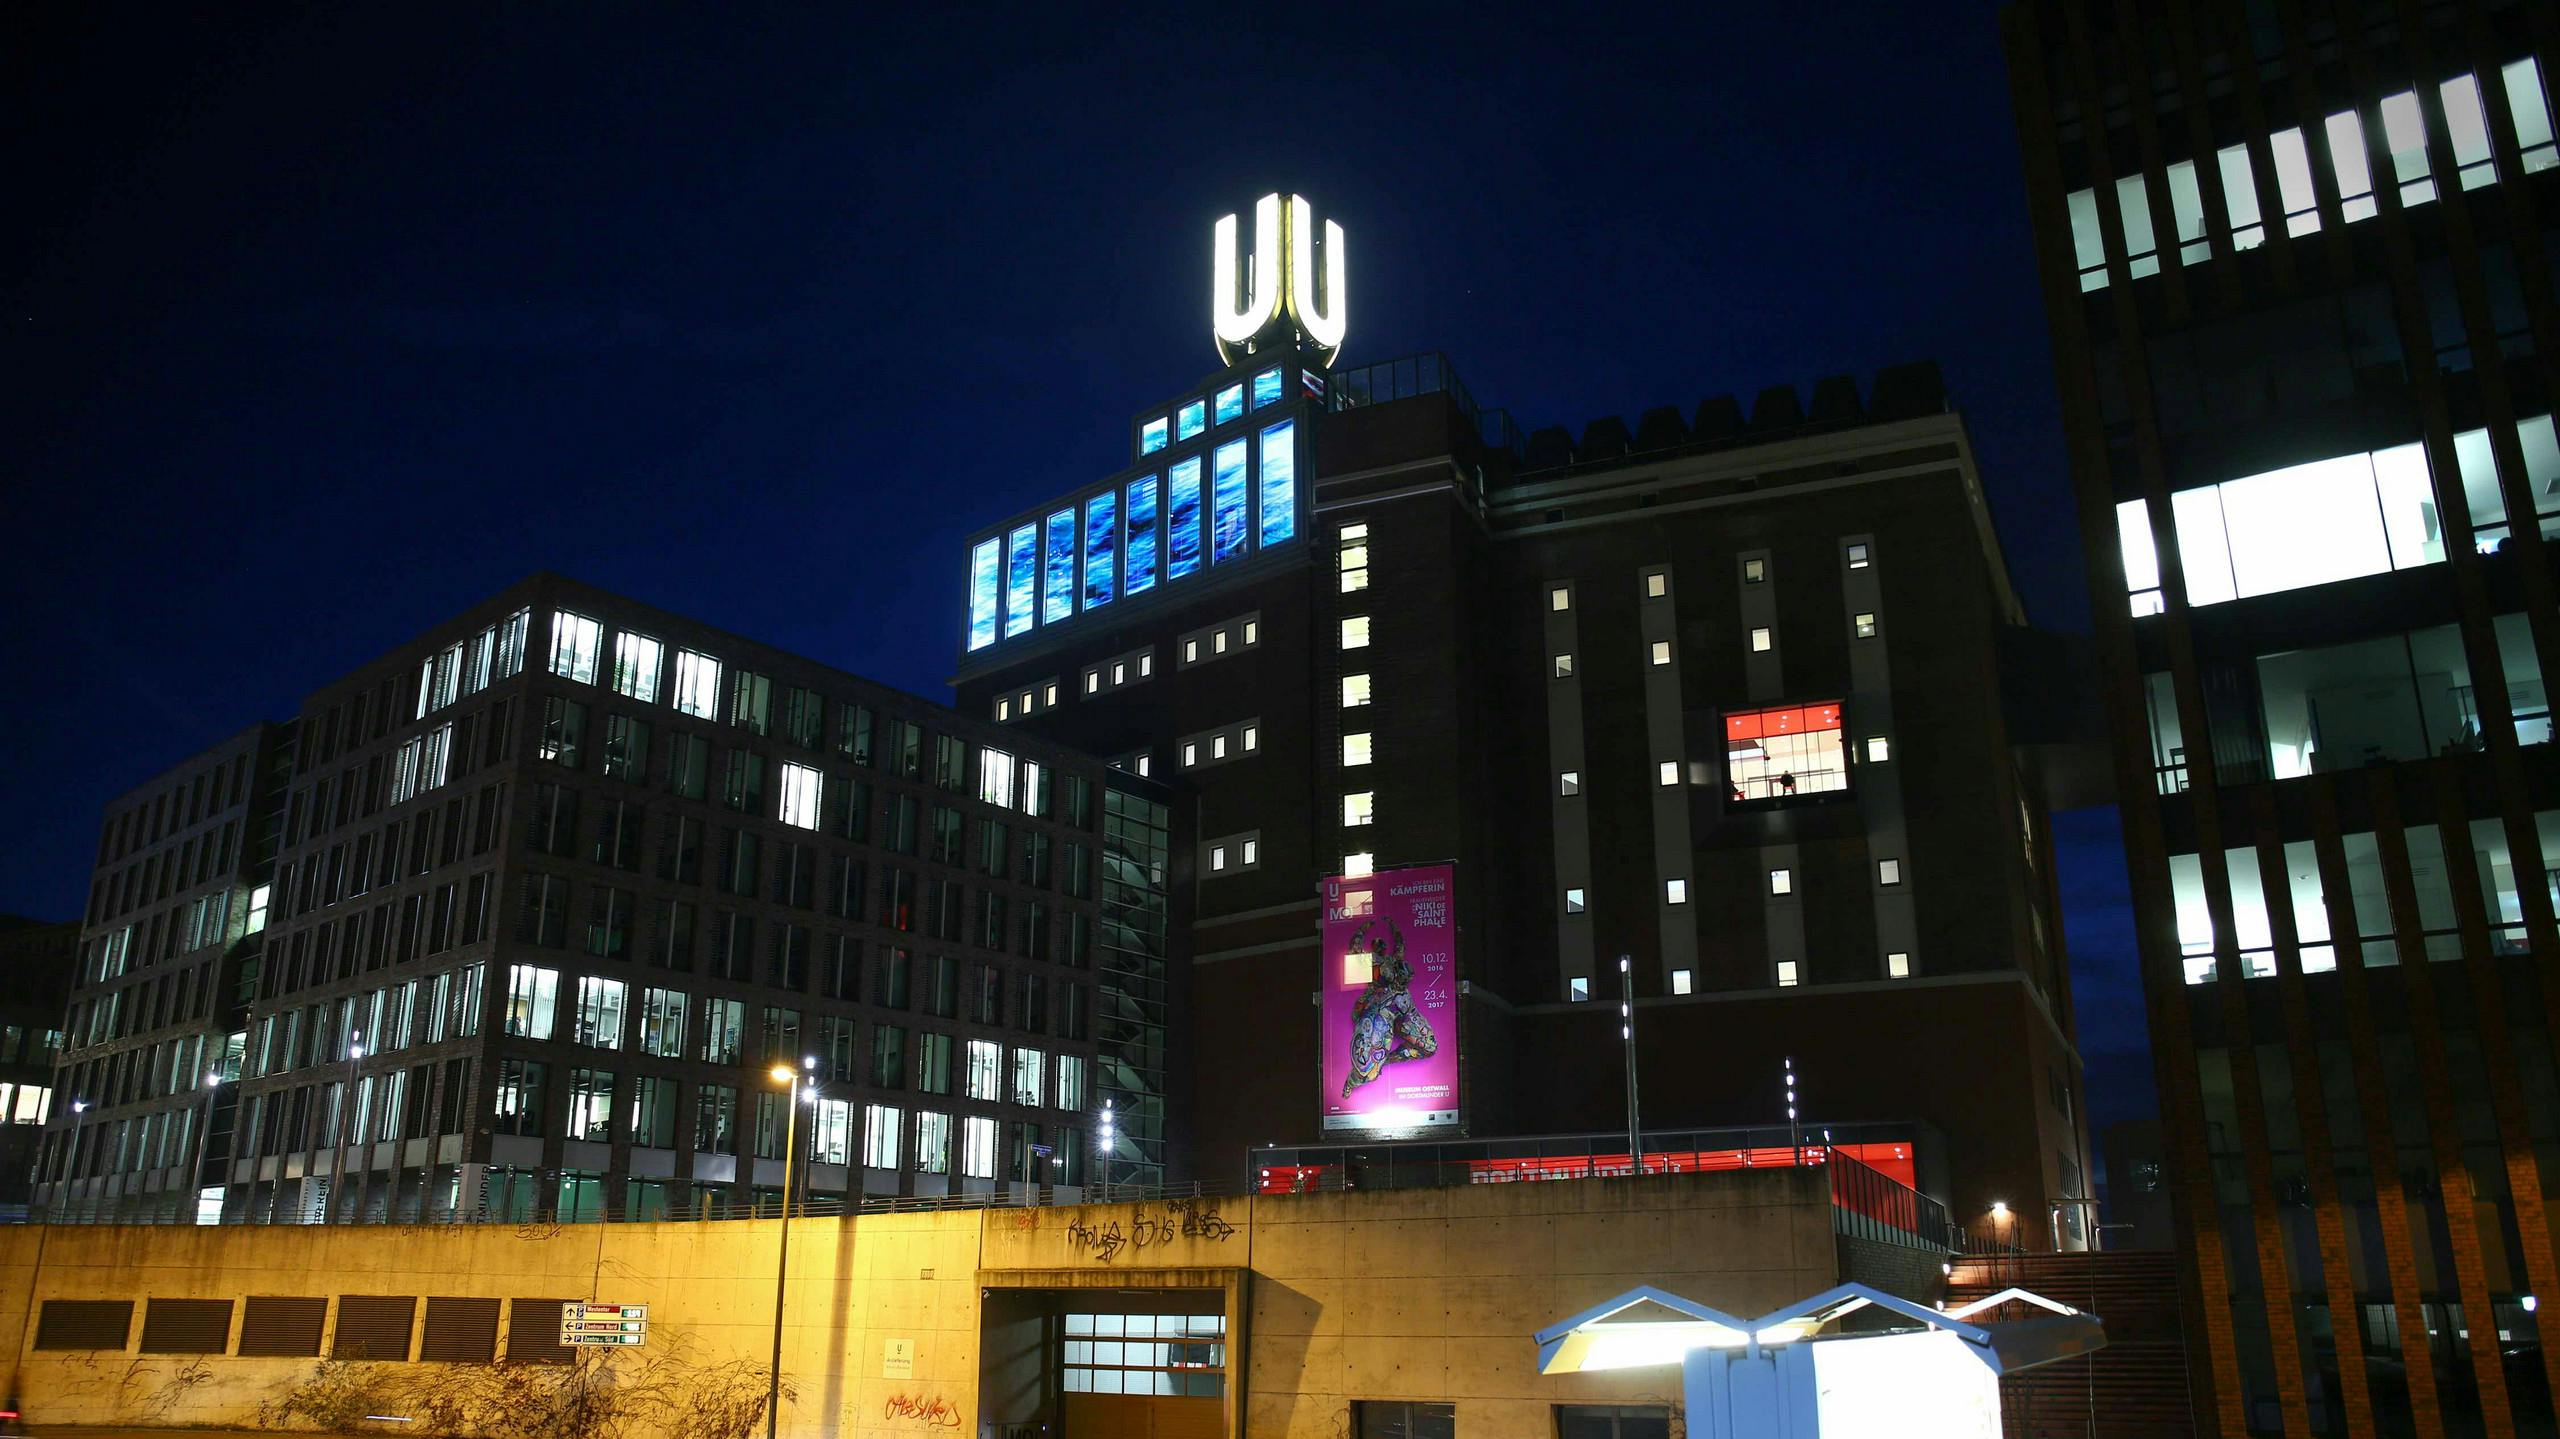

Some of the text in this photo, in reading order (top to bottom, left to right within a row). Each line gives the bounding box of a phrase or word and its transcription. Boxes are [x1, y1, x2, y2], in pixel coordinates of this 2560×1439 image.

[1390, 883, 1445, 896] KÄMPFERIN
[1415, 902, 1436, 911] NIKI
[1418, 909, 1446, 919] SAINT
[1422, 952, 1448, 964] 10.12.
[1424, 989, 1448, 1001] 23.4.
[1427, 1001, 1444, 1009] 2017
[1422, 1084, 1450, 1092] OSTWALL
